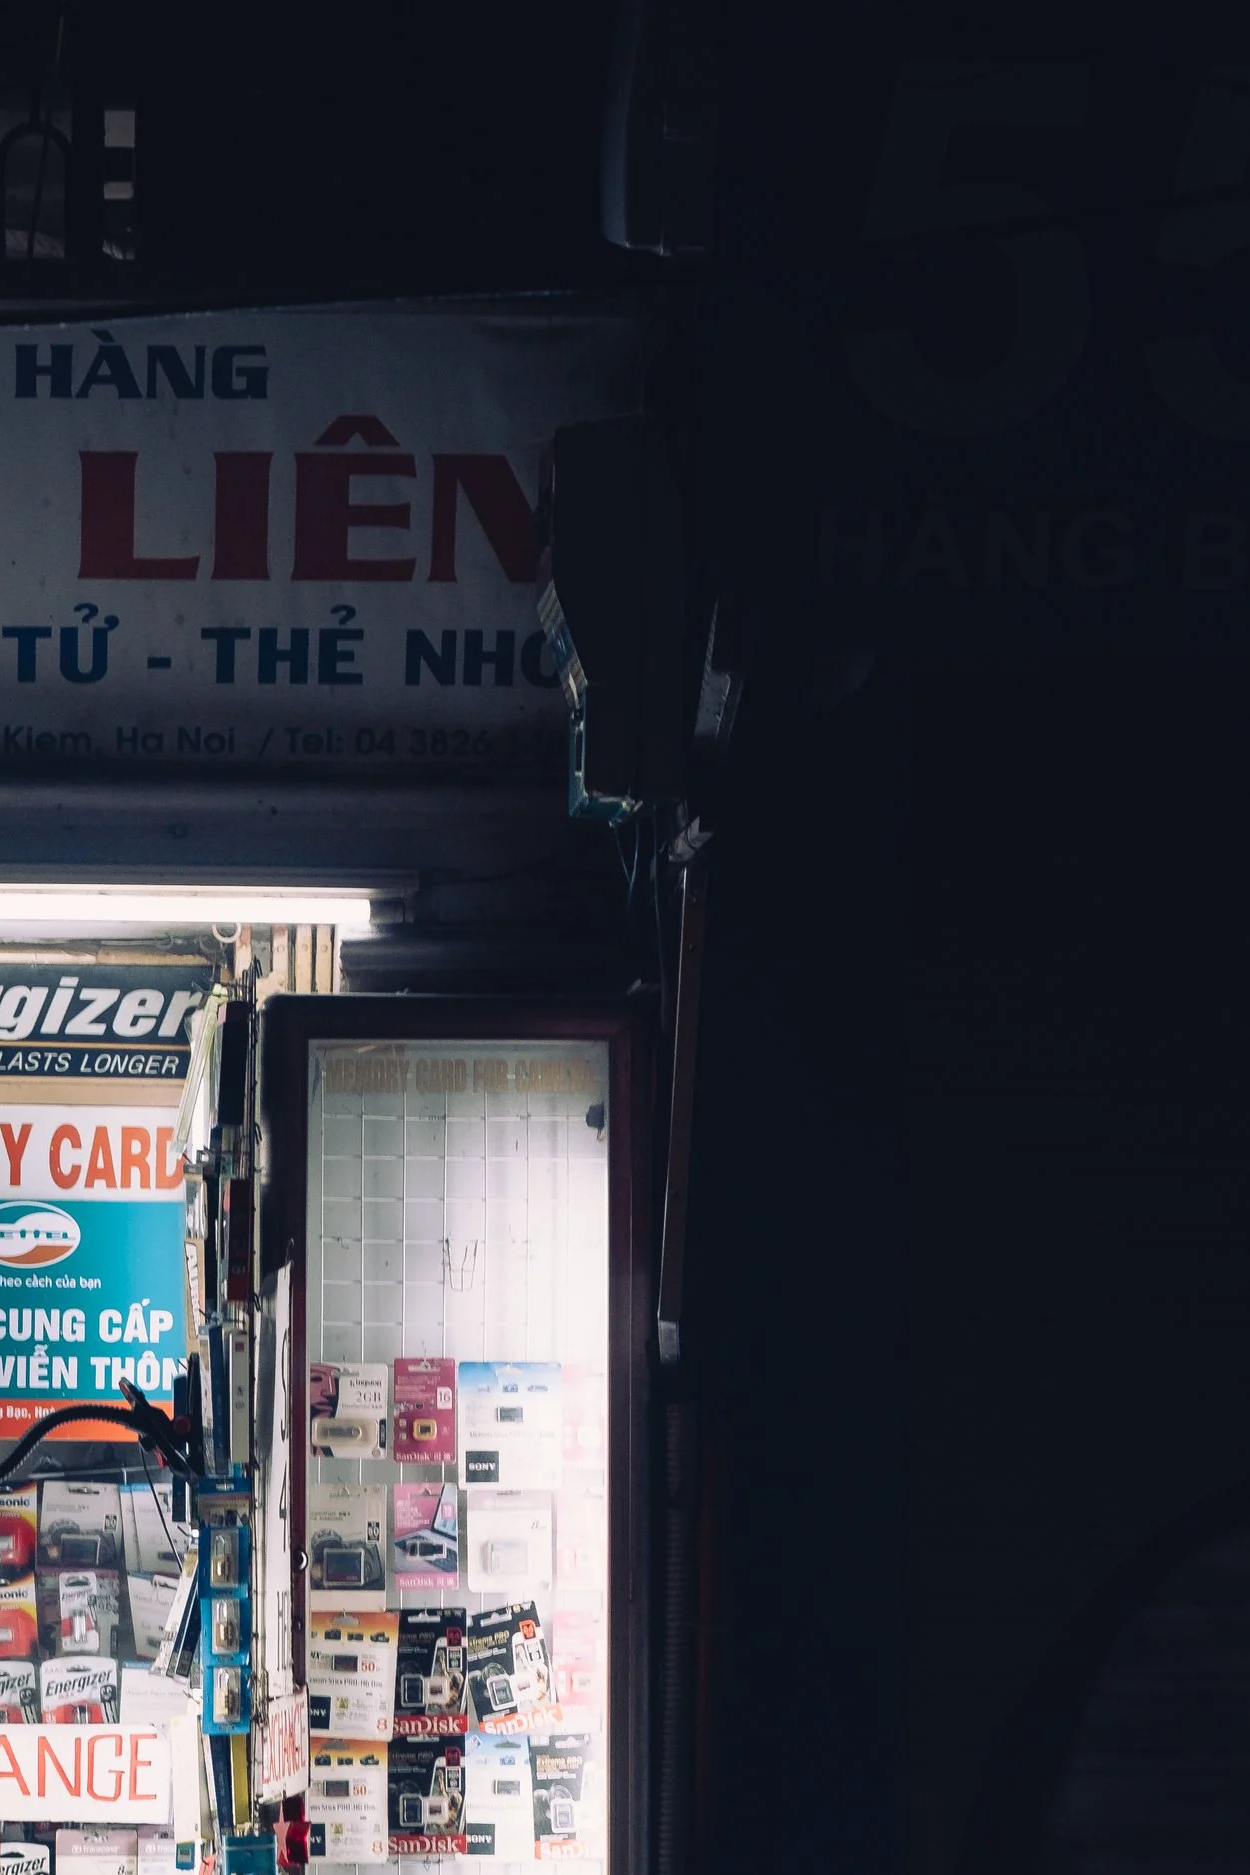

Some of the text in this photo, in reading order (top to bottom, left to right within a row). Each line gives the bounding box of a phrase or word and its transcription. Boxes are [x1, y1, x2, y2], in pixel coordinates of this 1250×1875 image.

[15, 329, 268, 400] HÀNG
[76, 414, 538, 584] LIÊN
[2, 602, 120, 685] TỬ
[201, 604, 365, 686] THẺ
[117, 726, 163, 755] Ha
[177, 725, 235, 755] Noi
[284, 725, 342, 756] Tel:
[355, 728, 395, 757] 04
[408, 728, 493, 757] 3826
[80, 1054, 180, 1076] LONGER
[51, 1123, 185, 1190] CARD
[98, 1298, 174, 1344] CẤP
[468, 1461, 496, 1471] SONY
[46, 1669, 112, 1697] Energizer
[393, 1717, 461, 1734] SanDisk
[484, 1709, 558, 1735] SanDisk
[387, 1836, 462, 1855] SanDisk
